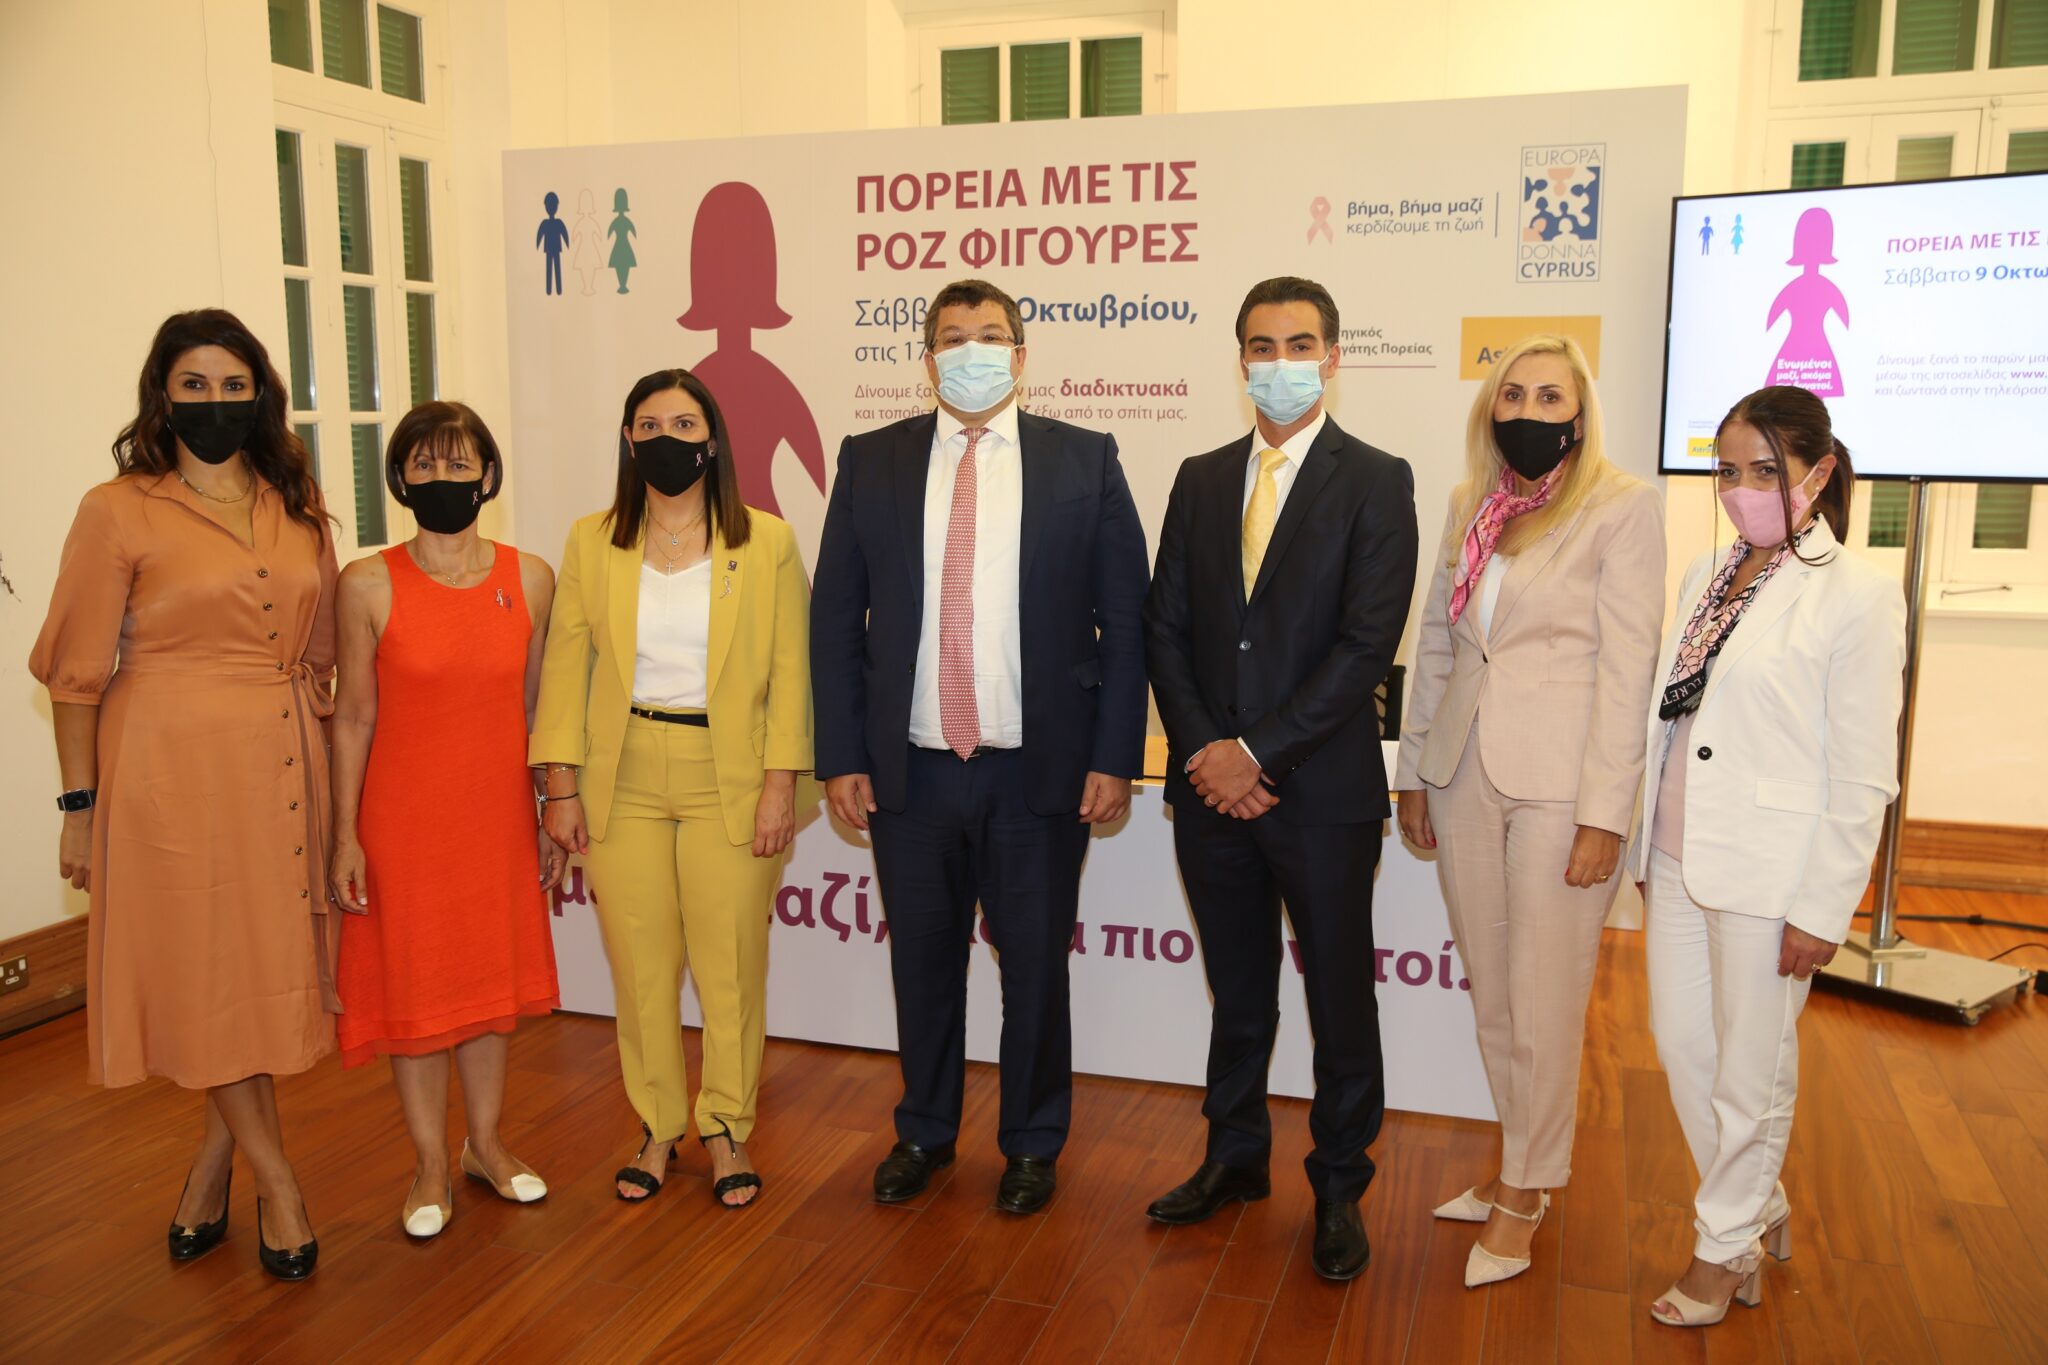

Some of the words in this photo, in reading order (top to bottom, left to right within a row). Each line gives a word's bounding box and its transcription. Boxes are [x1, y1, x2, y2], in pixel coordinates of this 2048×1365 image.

[1524, 148, 1601, 167] EUROPA
[857, 168, 1028, 213] ΠΟΡΕΙΑ
[1041, 164, 1111, 206] ΜΕ
[1122, 160, 1198, 202] ΤΙΣ
[1347, 200, 1394, 218] βήμα,
[1399, 199, 1442, 216] βήμα
[1447, 197, 1484, 215] μαζί
[1346, 218, 1431, 236] κερδίζουμε
[1435, 220, 1451, 232] τη
[1454, 216, 1484, 233] ζωή
[857, 231, 947, 271] ΡΟΖ
[959, 222, 1199, 269] ΦΙΓΟΥΡΕΣ
[1521, 243, 1598, 261] DONNA
[1887, 235, 1963, 254] ΠΟΡΕΙΑ
[1971, 232, 2002, 249] ΜΕ
[2007, 230, 2041, 247] ΤΙΣ
[1520, 261, 1596, 279] CYPRUS
[1884, 266, 1970, 288] Σάββατο
[1975, 265, 1987, 281] 9
[855, 297, 928, 332] Σάββ
[1016, 294, 1198, 328] Οκτωβρίου,
[1339, 326, 1382, 340] ηγικός
[855, 345, 897, 364] στις
[1342, 342, 1378, 356] γάτης
[1381, 342, 1432, 356] Πορείας
[1777, 358, 1832, 371] Ενωμένοι
[1876, 354, 1925, 366] Δίνουμε
[1928, 354, 1959, 366] ξανά
[1963, 355, 1977, 365] το
[854, 384, 912, 401] Δίνουμε
[915, 383, 935, 400] ξα
[1028, 386, 1056, 401] μας
[1060, 378, 1188, 398] διαδικτυακά
[855, 408, 875, 419] και
[1064, 404, 1094, 419] από
[1098, 407, 1114, 419] το
[1117, 405, 1152, 420] σπίτι
[1156, 407, 1187, 422] μας.
[1662, 677, 1703, 706] ECRET
[768, 871, 888, 943] αζί,
[1100, 923, 1195, 964] πιο
